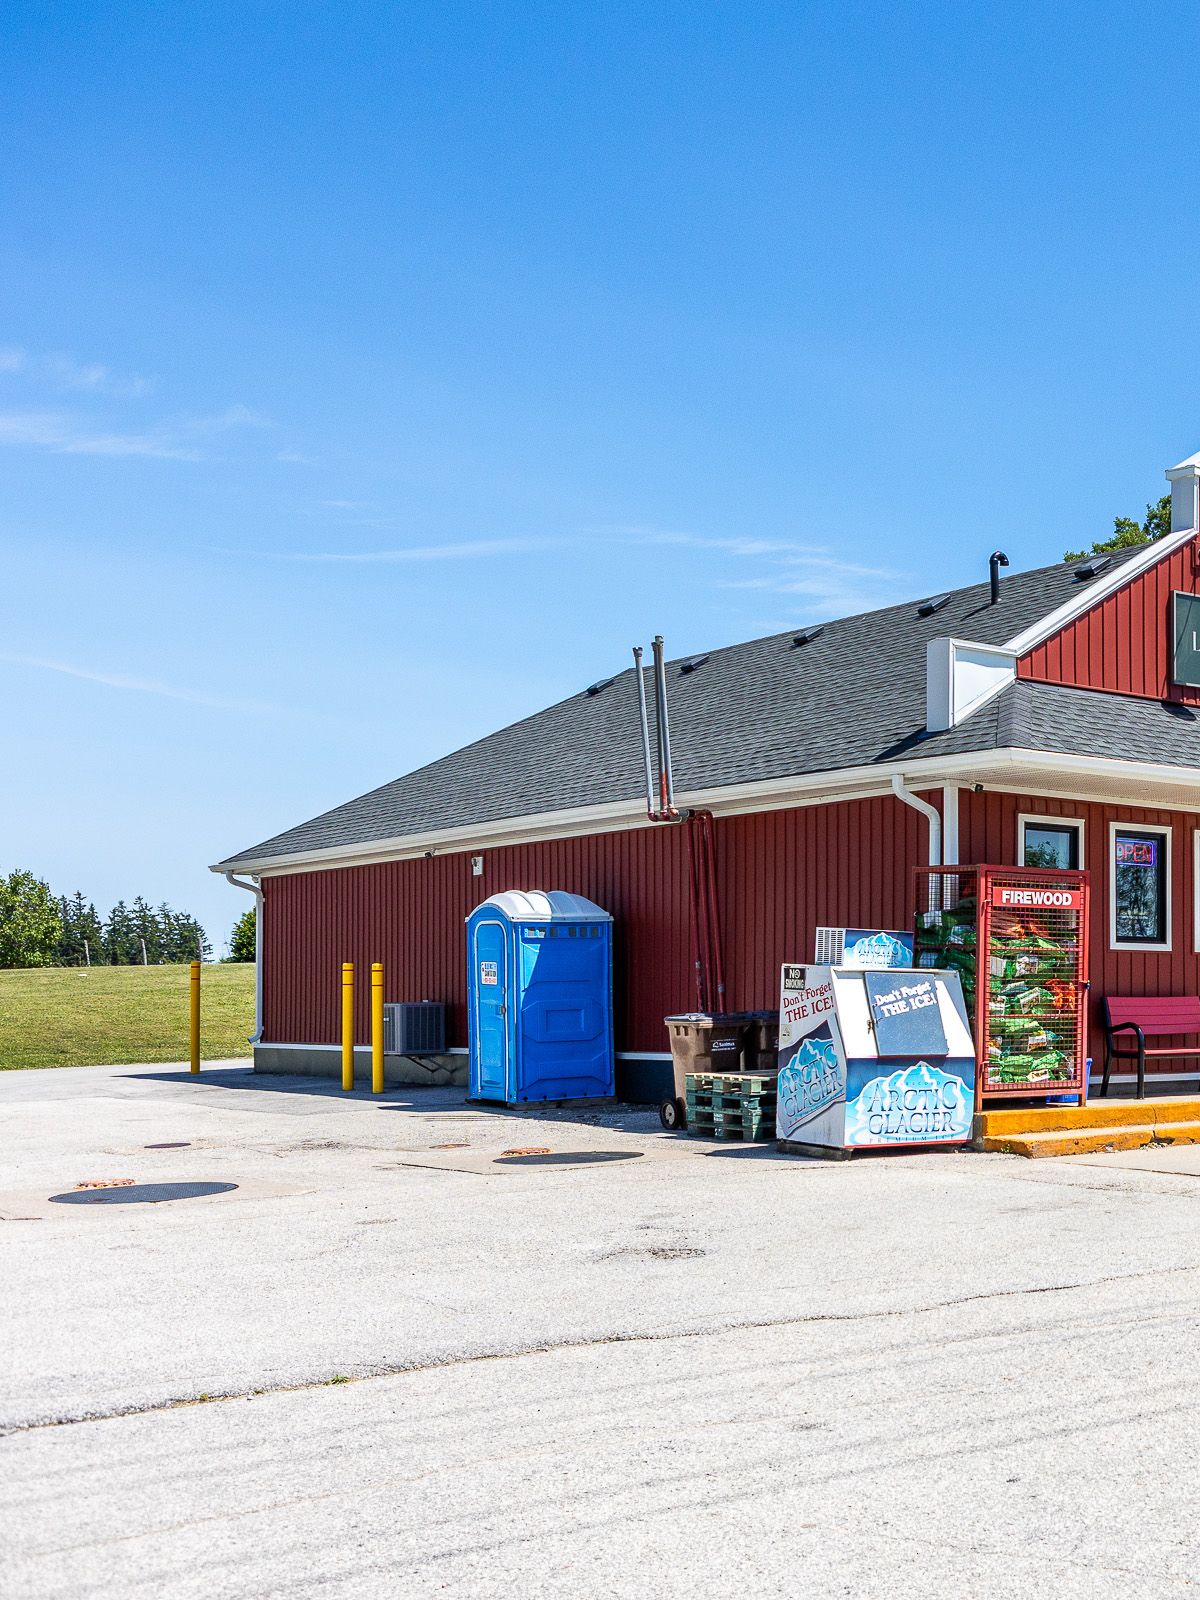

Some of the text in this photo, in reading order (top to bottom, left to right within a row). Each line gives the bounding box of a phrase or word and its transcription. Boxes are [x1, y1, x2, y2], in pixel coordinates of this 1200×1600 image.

[1117, 843, 1152, 862] OPEN
[1002, 890, 1073, 906] FIREWOOD
[789, 969, 801, 978] NO
[783, 981, 832, 1008] Don't Forget
[874, 981, 932, 1006] Don't Forget
[880, 992, 938, 1018] THE ICE!
[785, 995, 835, 1023] THE ICE!
[781, 1043, 838, 1098] ARCTIC
[784, 1070, 843, 1117] GLACIER
[867, 1081, 958, 1112] ARCTIC
[868, 1111, 956, 1135] GLACIER
